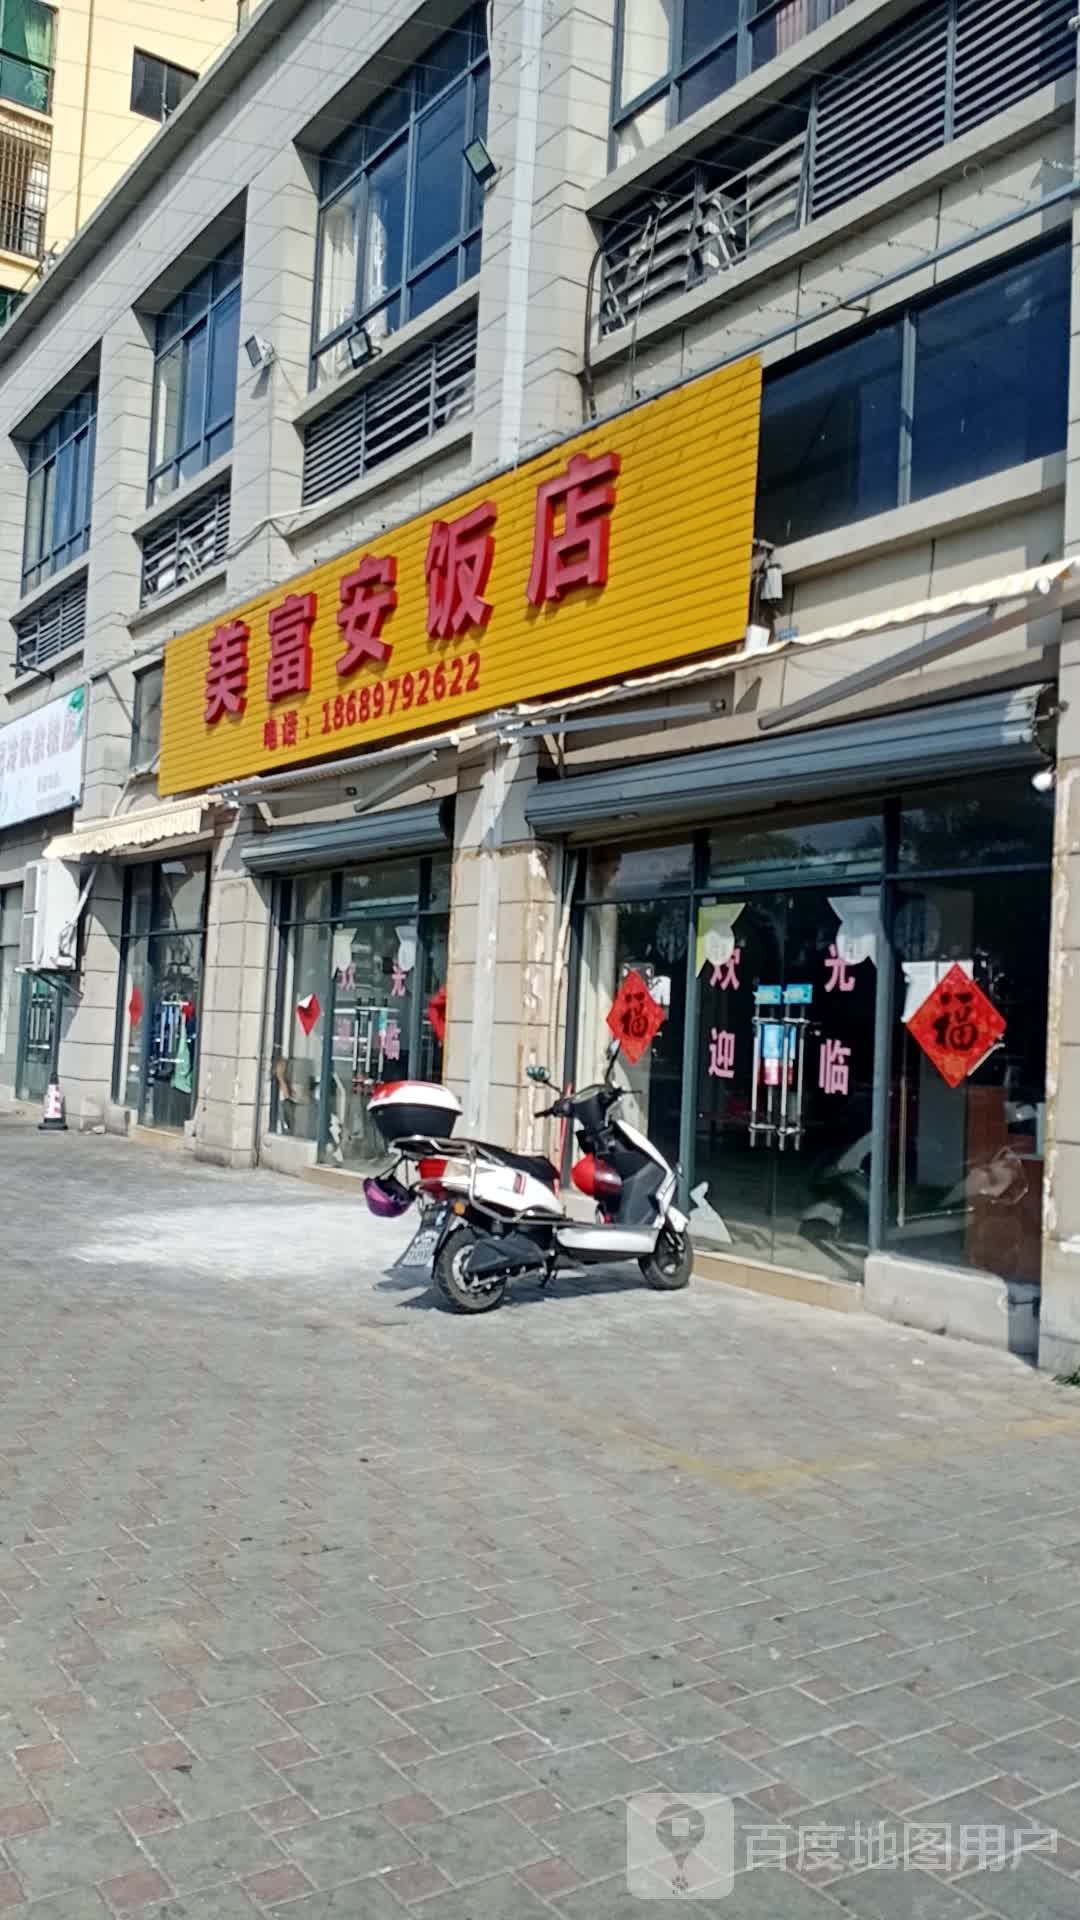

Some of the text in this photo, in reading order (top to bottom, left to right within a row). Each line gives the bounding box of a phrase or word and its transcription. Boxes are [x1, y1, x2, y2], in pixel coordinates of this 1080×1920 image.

[205, 450, 622, 726] 美富安饭店
[931, 991, 977, 1052] 福
